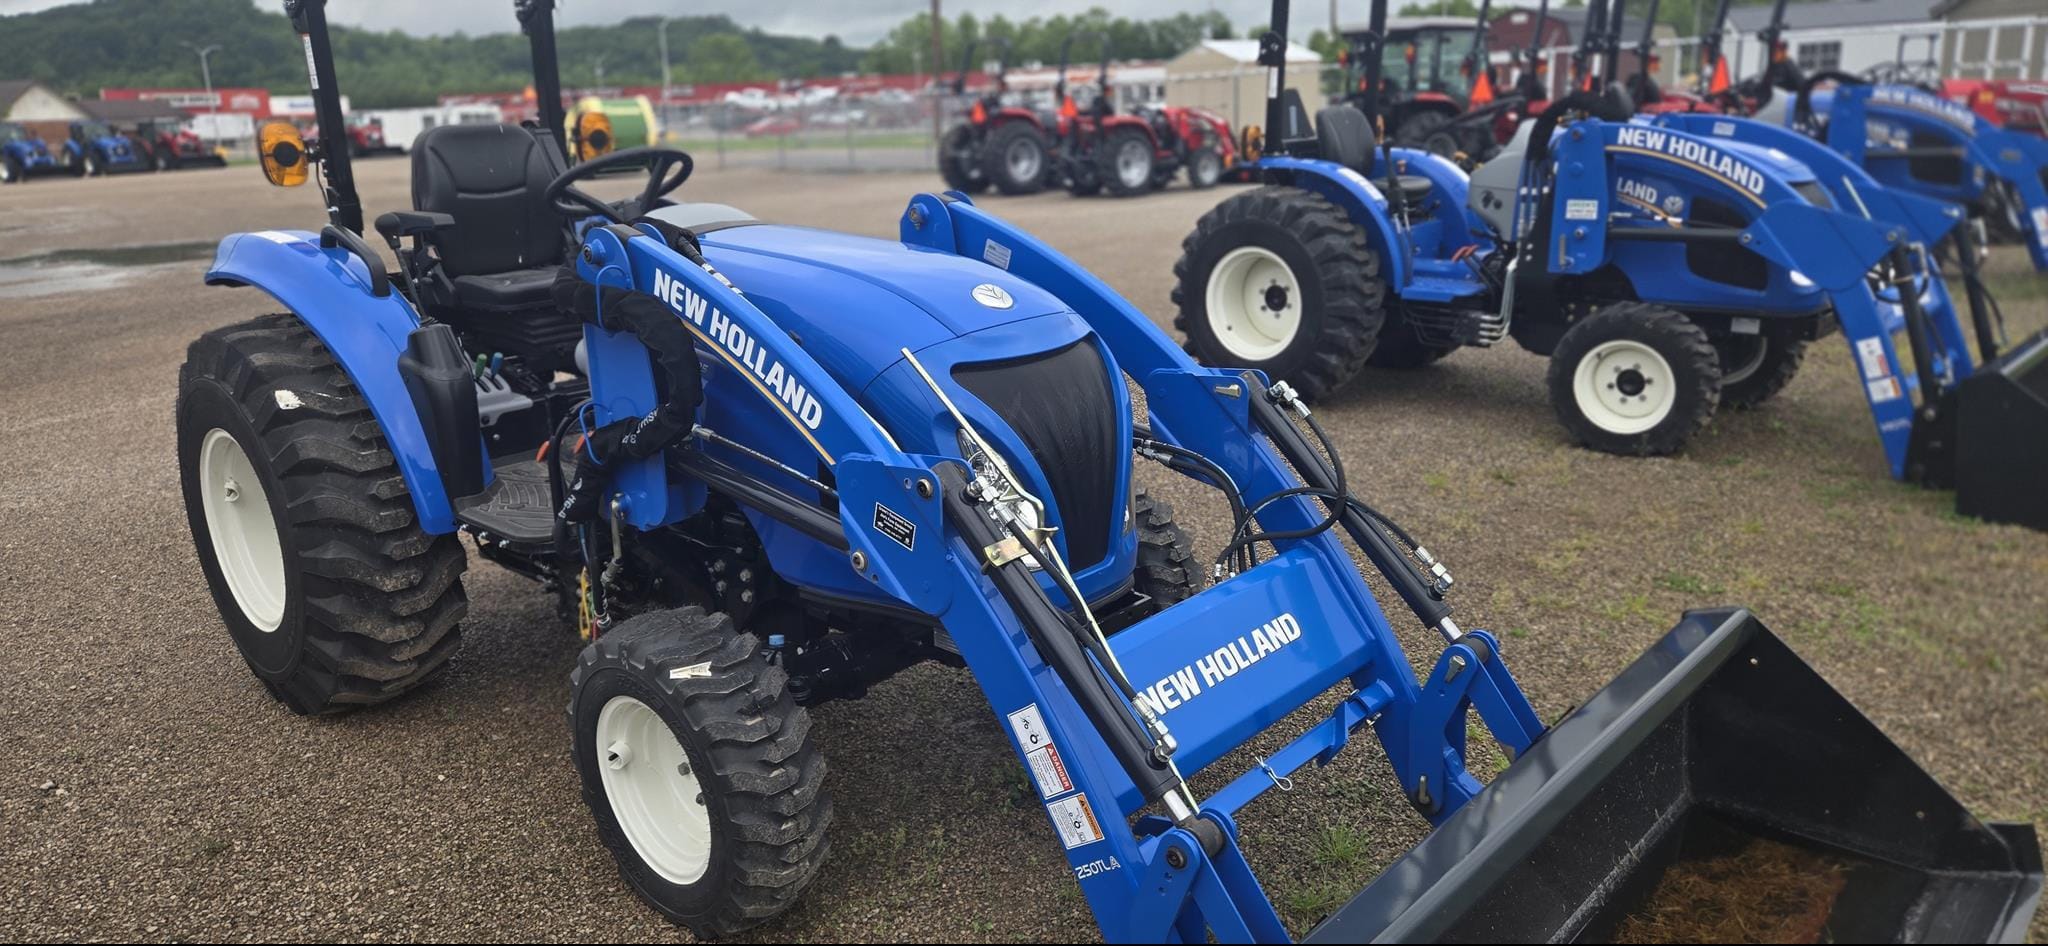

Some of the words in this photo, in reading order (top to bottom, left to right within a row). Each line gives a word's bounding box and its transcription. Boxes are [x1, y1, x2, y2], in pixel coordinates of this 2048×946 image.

[1617, 127, 1666, 152] NEW
[1667, 136, 1765, 195] HOLLAND
[654, 268, 707, 326] NEW
[709, 307, 823, 430] HOLLAND
[1138, 665, 1202, 716] NEW
[1195, 613, 1302, 688] HOLLAND
[1051, 755, 1069, 788] DANGER
[1075, 855, 1121, 880] 250TLA
